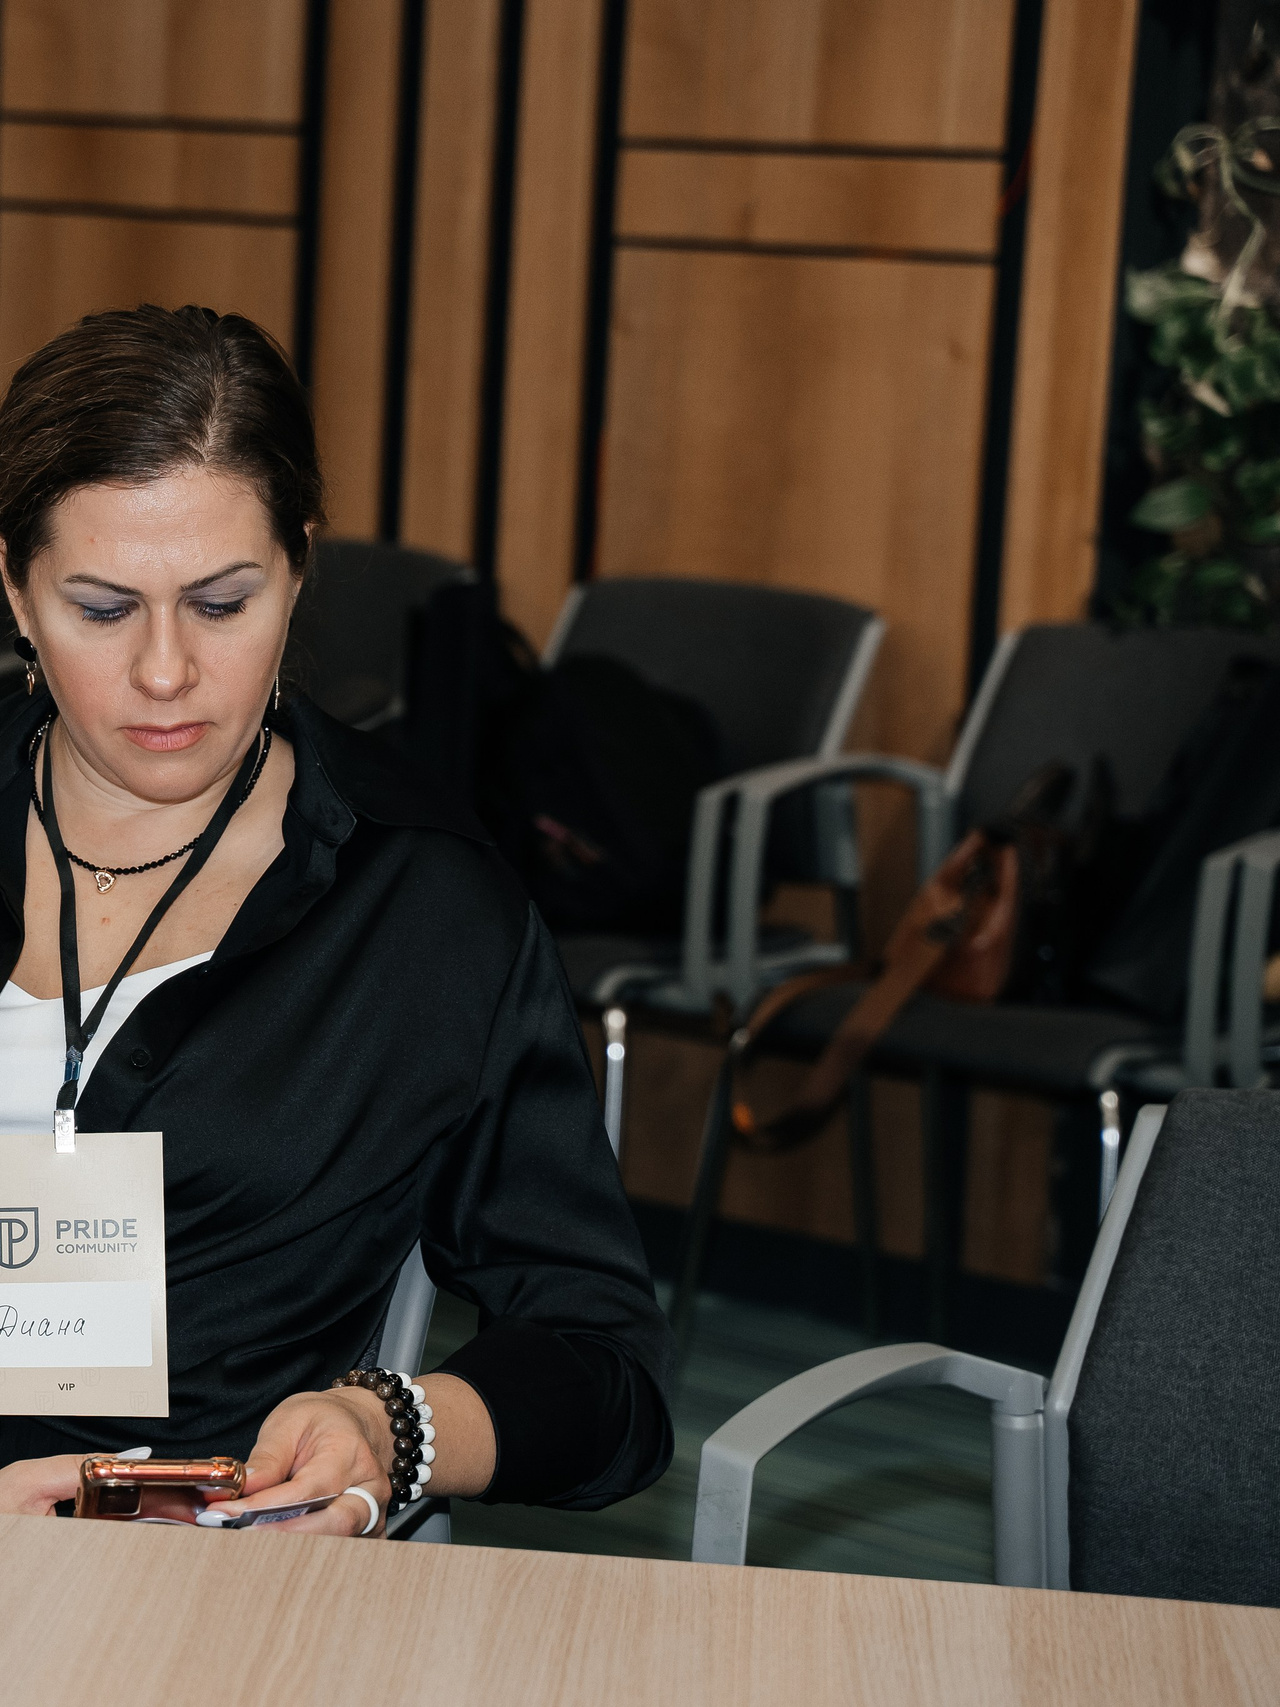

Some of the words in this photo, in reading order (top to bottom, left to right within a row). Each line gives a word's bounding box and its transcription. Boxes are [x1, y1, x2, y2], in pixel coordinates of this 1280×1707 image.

[55, 1218, 138, 1240] PRIDE
[56, 1242, 138, 1255] COMMUNITY
[57, 1383, 76, 1391] VIP
